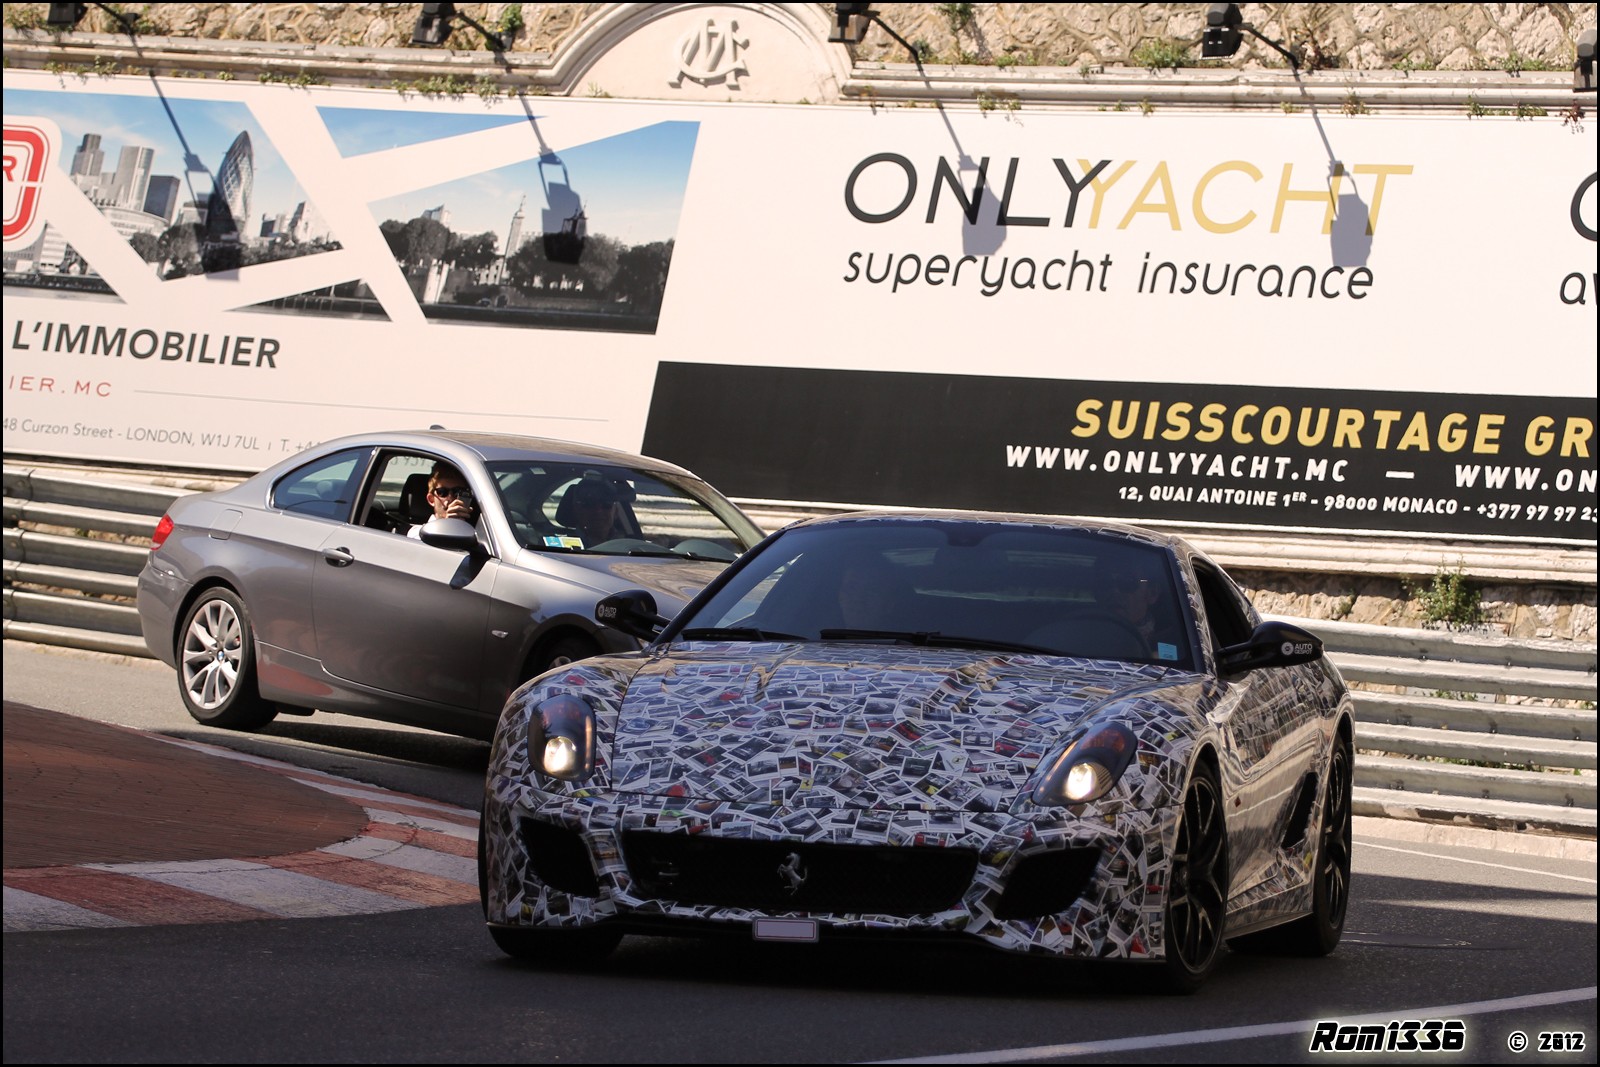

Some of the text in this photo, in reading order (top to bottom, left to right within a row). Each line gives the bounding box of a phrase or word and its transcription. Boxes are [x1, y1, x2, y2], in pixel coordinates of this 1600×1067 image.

[843, 250, 1374, 299] superyacht insurance
[22, 418, 69, 434] Curzon
[73, 422, 114, 439] Street
[126, 427, 195, 447] LONDON,
[201, 433, 231, 448] W1J
[234, 435, 260, 450] 7UL
[1071, 399, 1594, 458] SUISSCOURTAGE GR
[1006, 445, 1348, 482] WWW.ONLYYACHT.MC
[1455, 464, 1597, 493] WWW.ON
[1118, 486, 1143, 503] 12,
[1149, 485, 1193, 502] QUAI
[1197, 488, 1278, 507] ANTOINE
[1324, 495, 1377, 511] 98000
[1383, 496, 1458, 514] MONACO
[1477, 503, 1521, 520] +377
[1526, 504, 1549, 521] 97
[1553, 506, 1577, 522] 97
